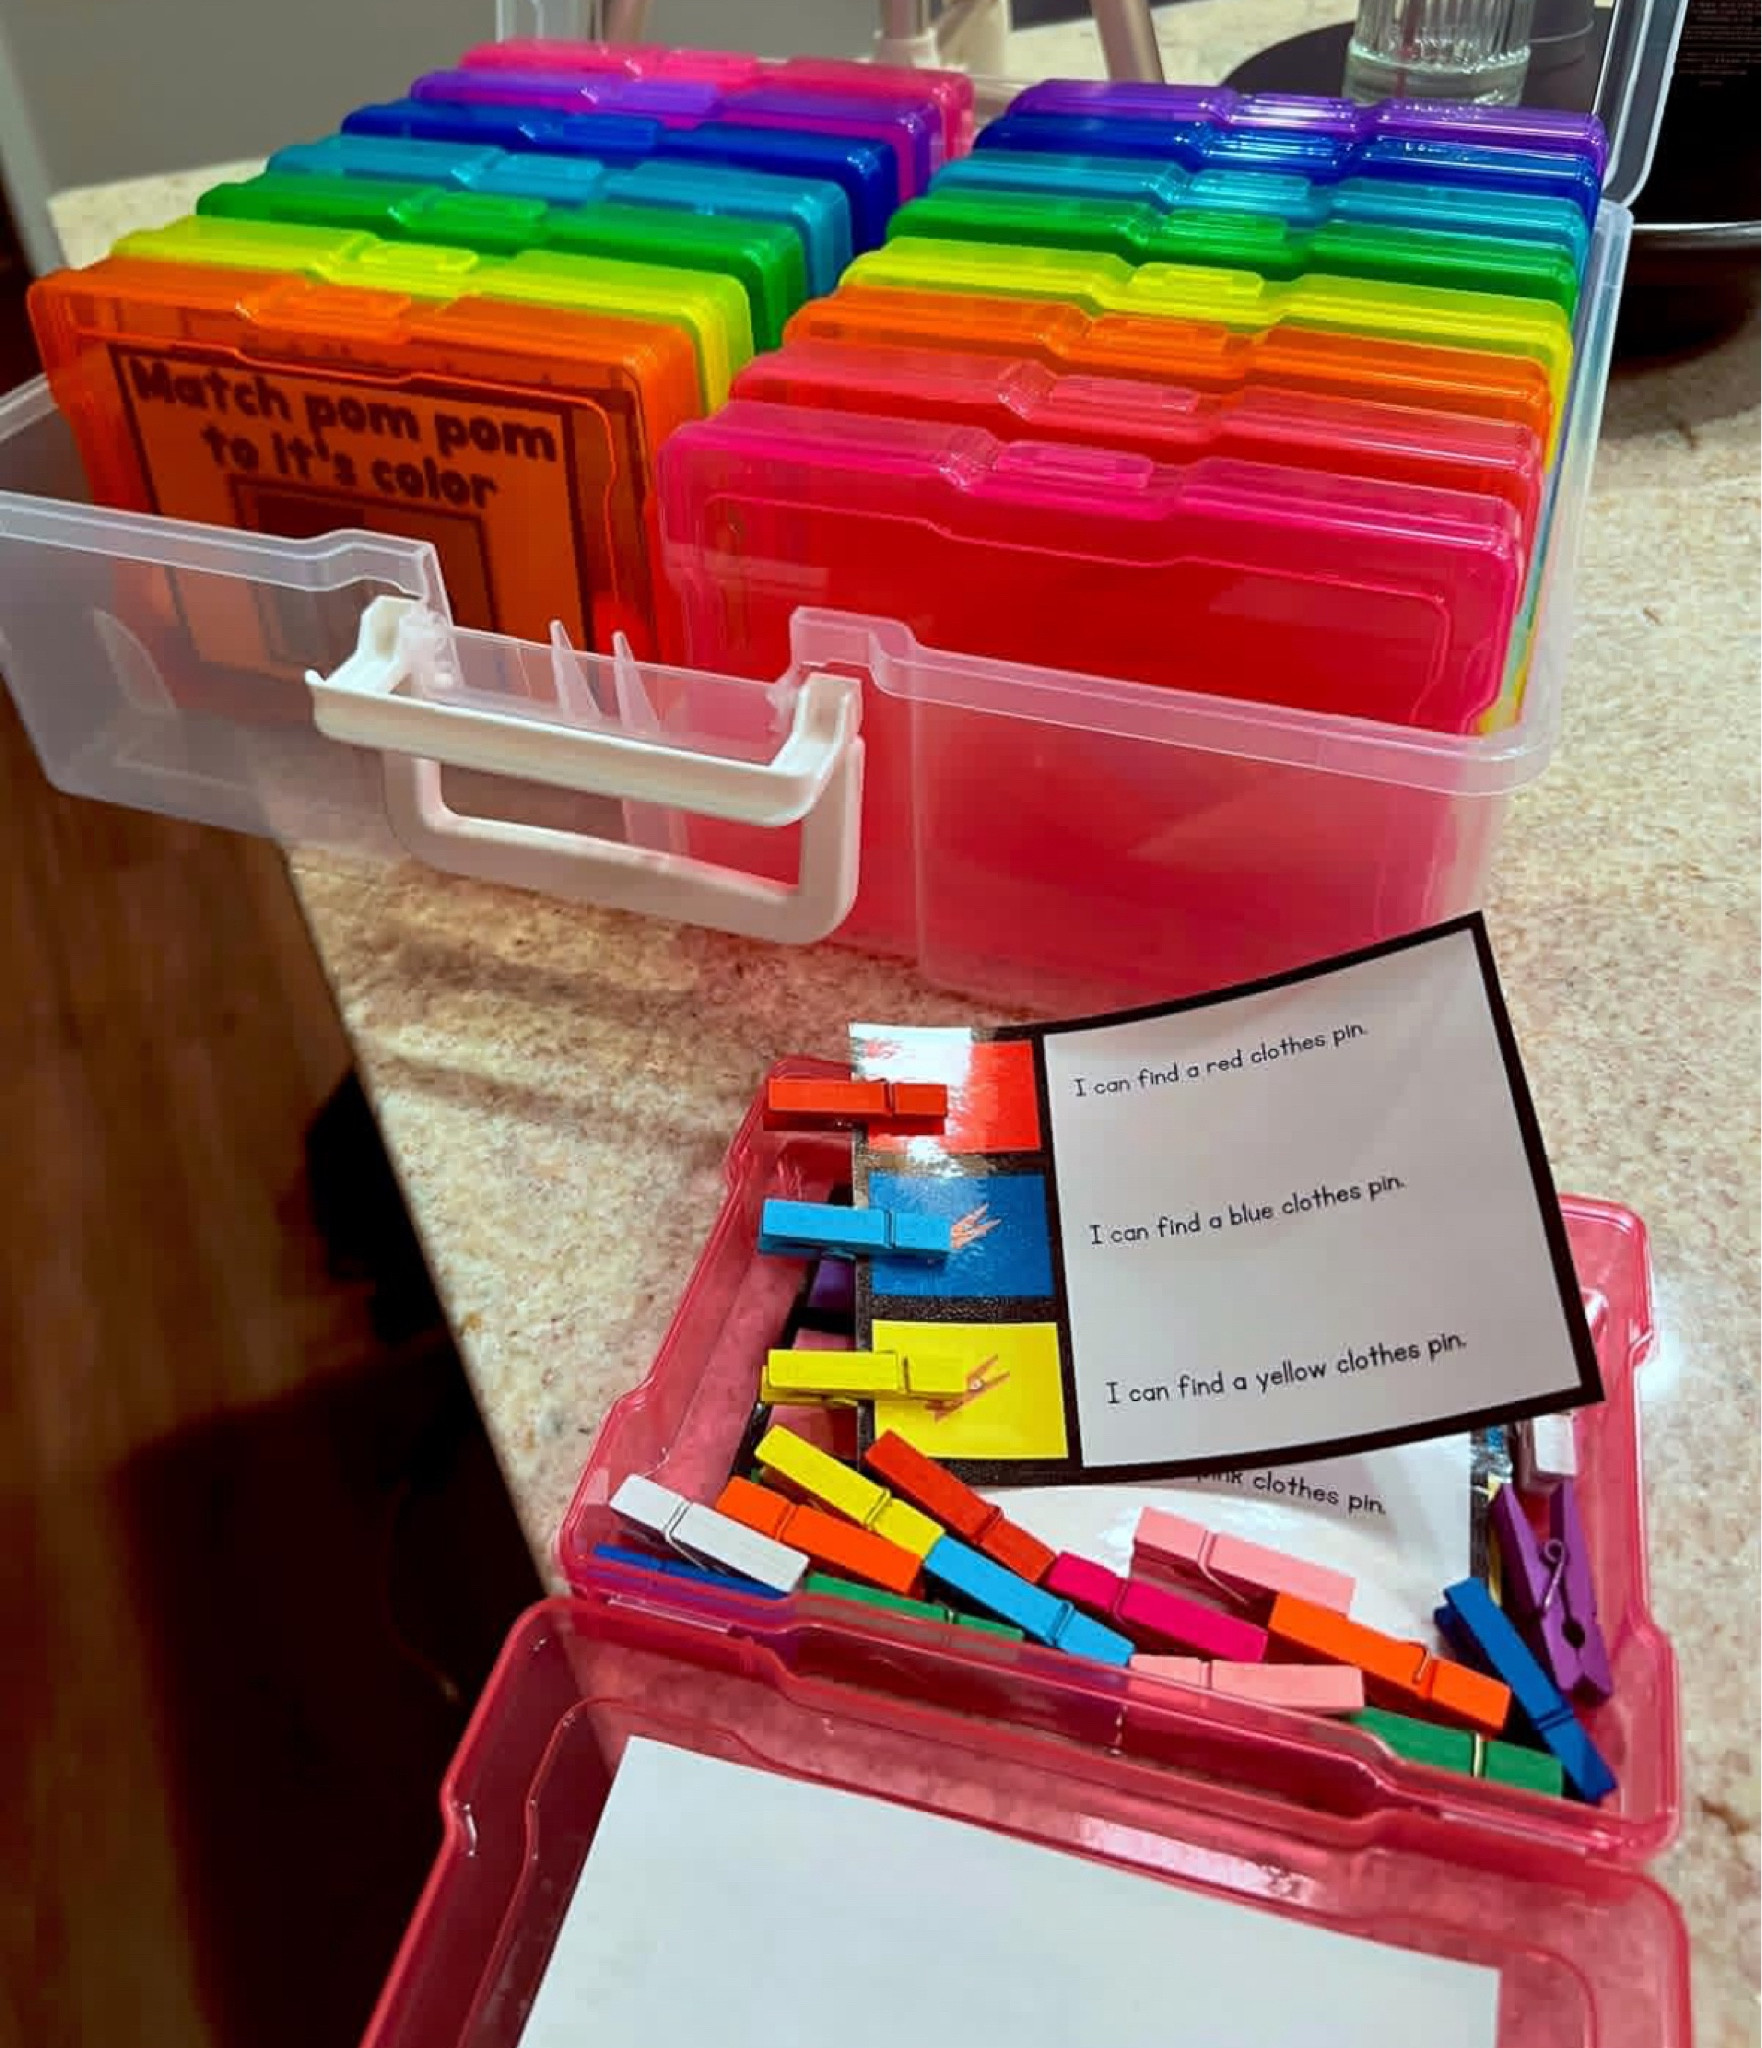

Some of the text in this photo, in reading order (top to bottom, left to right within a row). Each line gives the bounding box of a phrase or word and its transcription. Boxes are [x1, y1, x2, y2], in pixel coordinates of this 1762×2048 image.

[129, 357, 557, 463] Match pom pom
[201, 423, 260, 470] to
[371, 456, 497, 510] color
[1074, 1024, 1368, 1097] I can find a red clothes pin.
[1089, 1175, 1406, 1245] I can find a blue clothes pin.
[1105, 1333, 1467, 1404] I can find a yellow clothes pin.
[1252, 1470, 1339, 1505] clothes
[1348, 1494, 1387, 1515] pin.
